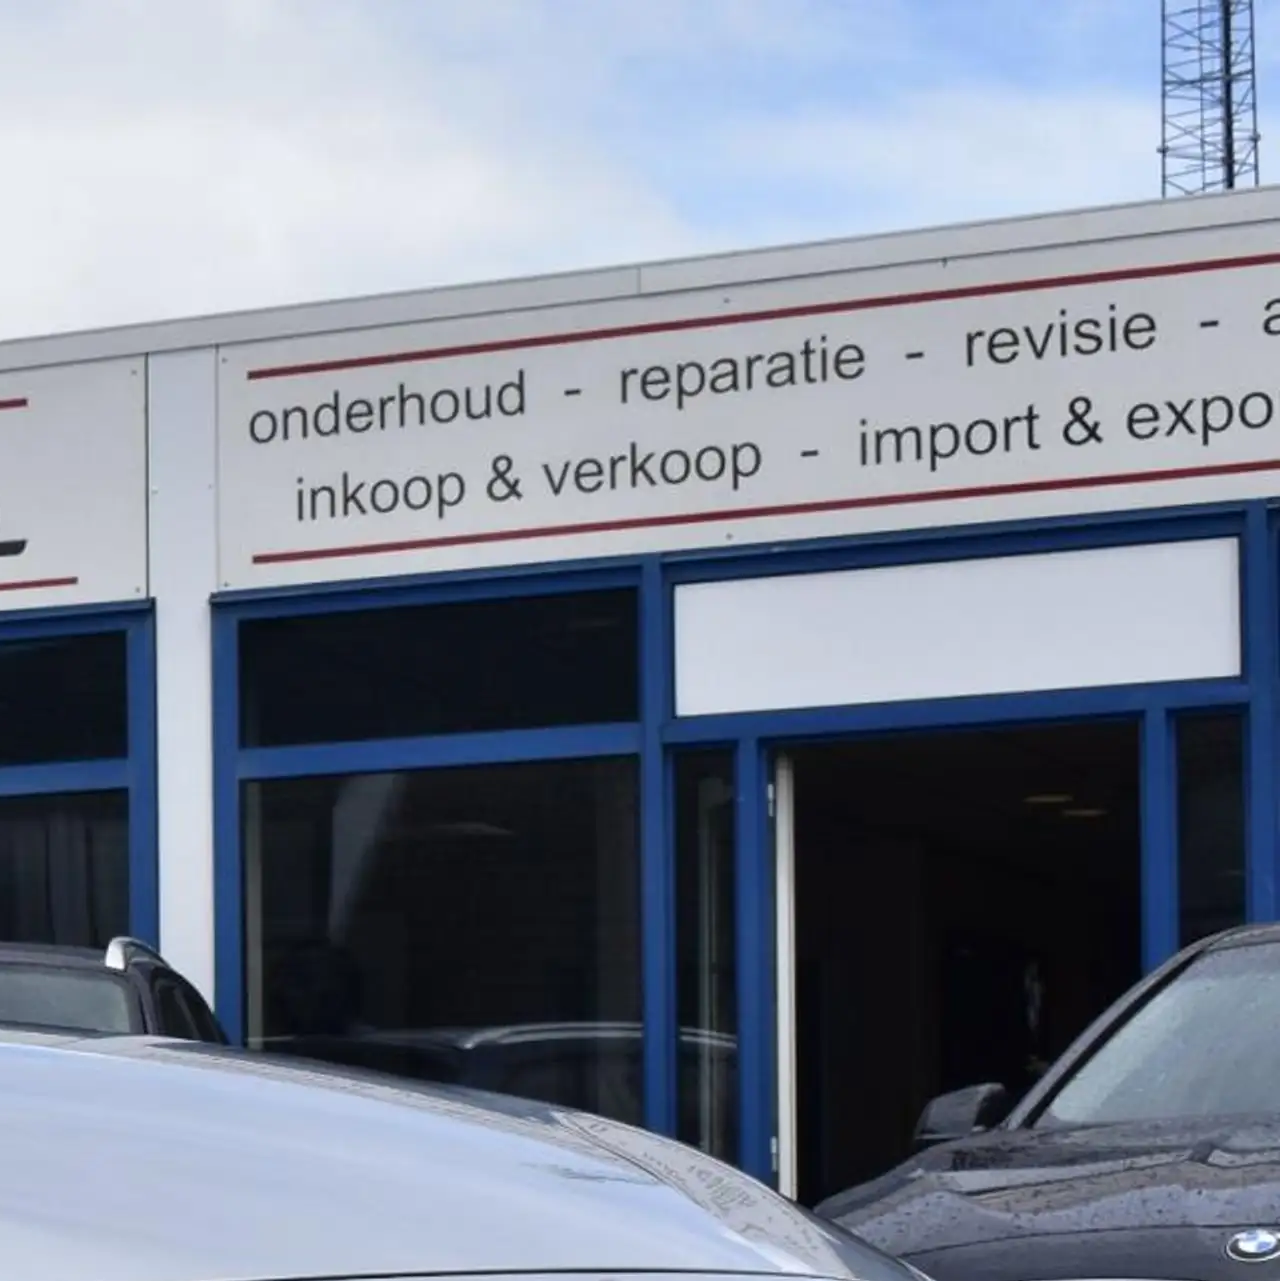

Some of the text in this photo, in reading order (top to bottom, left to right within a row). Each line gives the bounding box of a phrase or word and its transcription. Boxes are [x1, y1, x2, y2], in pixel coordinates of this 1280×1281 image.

[247, 369, 526, 445] onderhoud
[621, 334, 866, 410] reparatie
[964, 305, 1157, 367] revisie
[296, 471, 466, 521] inkoop
[486, 455, 524, 502] &
[543, 438, 762, 496] verkoop
[860, 403, 1041, 471] import
[1062, 396, 1104, 446] &
